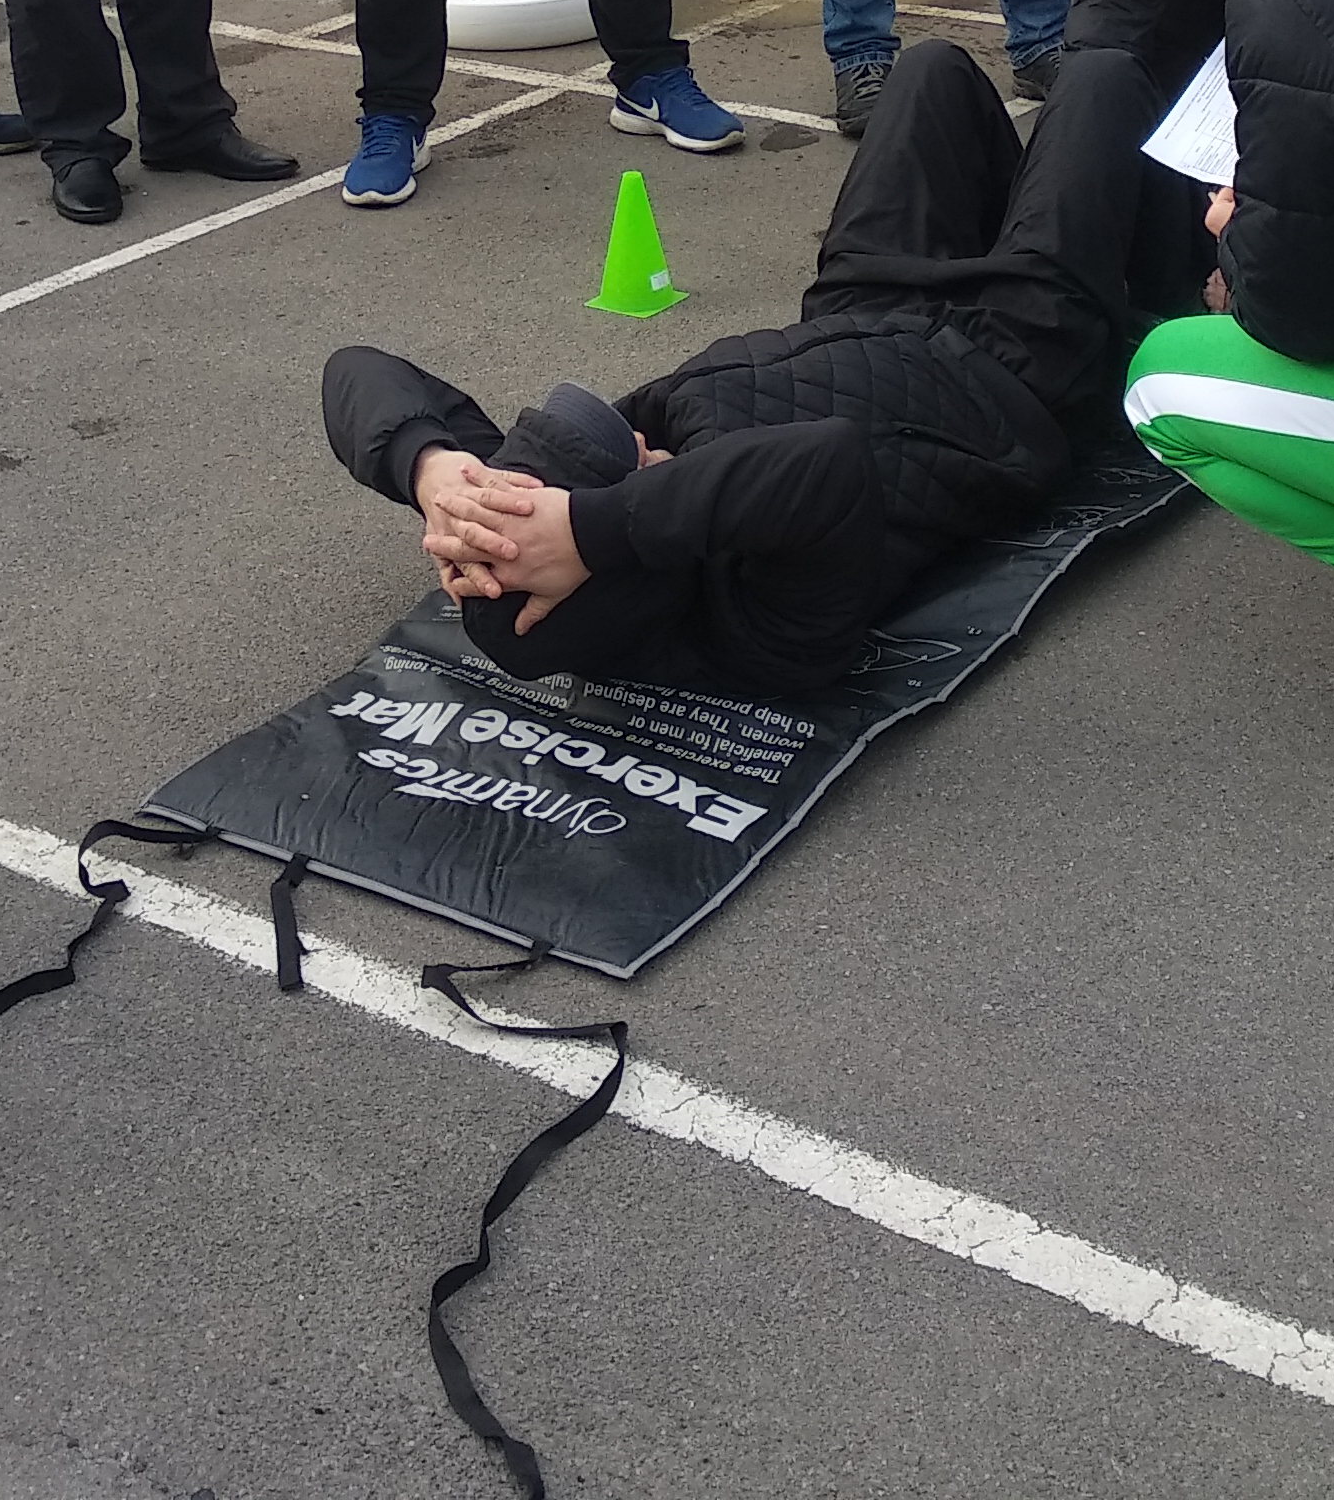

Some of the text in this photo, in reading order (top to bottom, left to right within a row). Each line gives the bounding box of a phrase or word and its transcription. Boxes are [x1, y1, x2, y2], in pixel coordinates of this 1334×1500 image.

[383, 656, 429, 672] toning,
[485, 678, 567, 709] contouring
[679, 691, 753, 715] promote
[583, 682, 804, 749] women. They are designed
[755, 707, 793, 733] help
[797, 722, 815, 738] to
[564, 717, 782, 784] These exercises are equally
[627, 715, 794, 767] beneficial for men or
[327, 678, 768, 842] Exercise Mat
